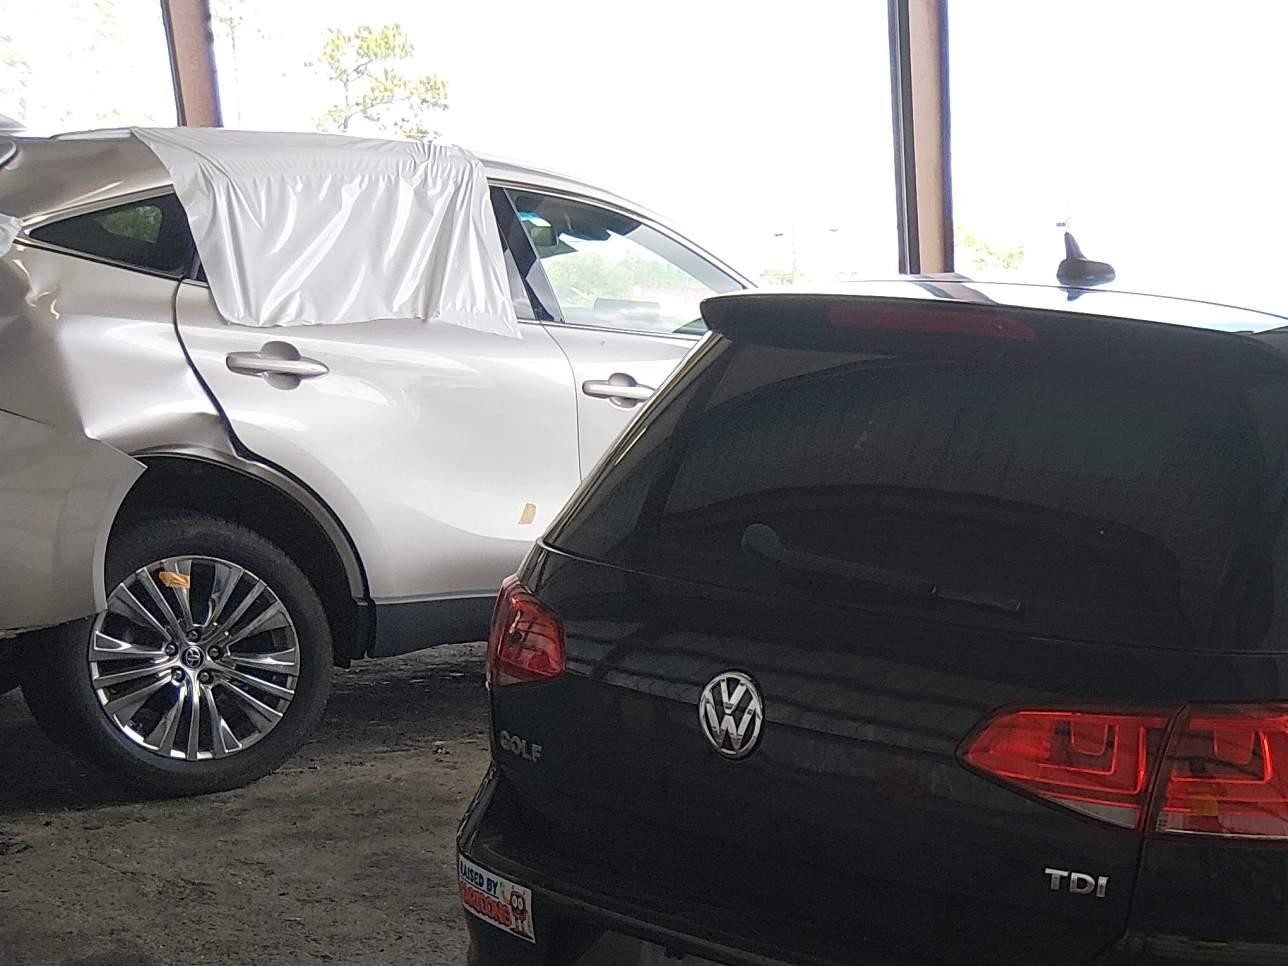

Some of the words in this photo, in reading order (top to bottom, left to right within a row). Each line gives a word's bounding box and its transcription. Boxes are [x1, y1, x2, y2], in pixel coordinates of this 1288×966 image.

[500, 730, 542, 763] GOLF
[487, 877, 498, 894] BY
[1045, 868, 1110, 897] TDI
